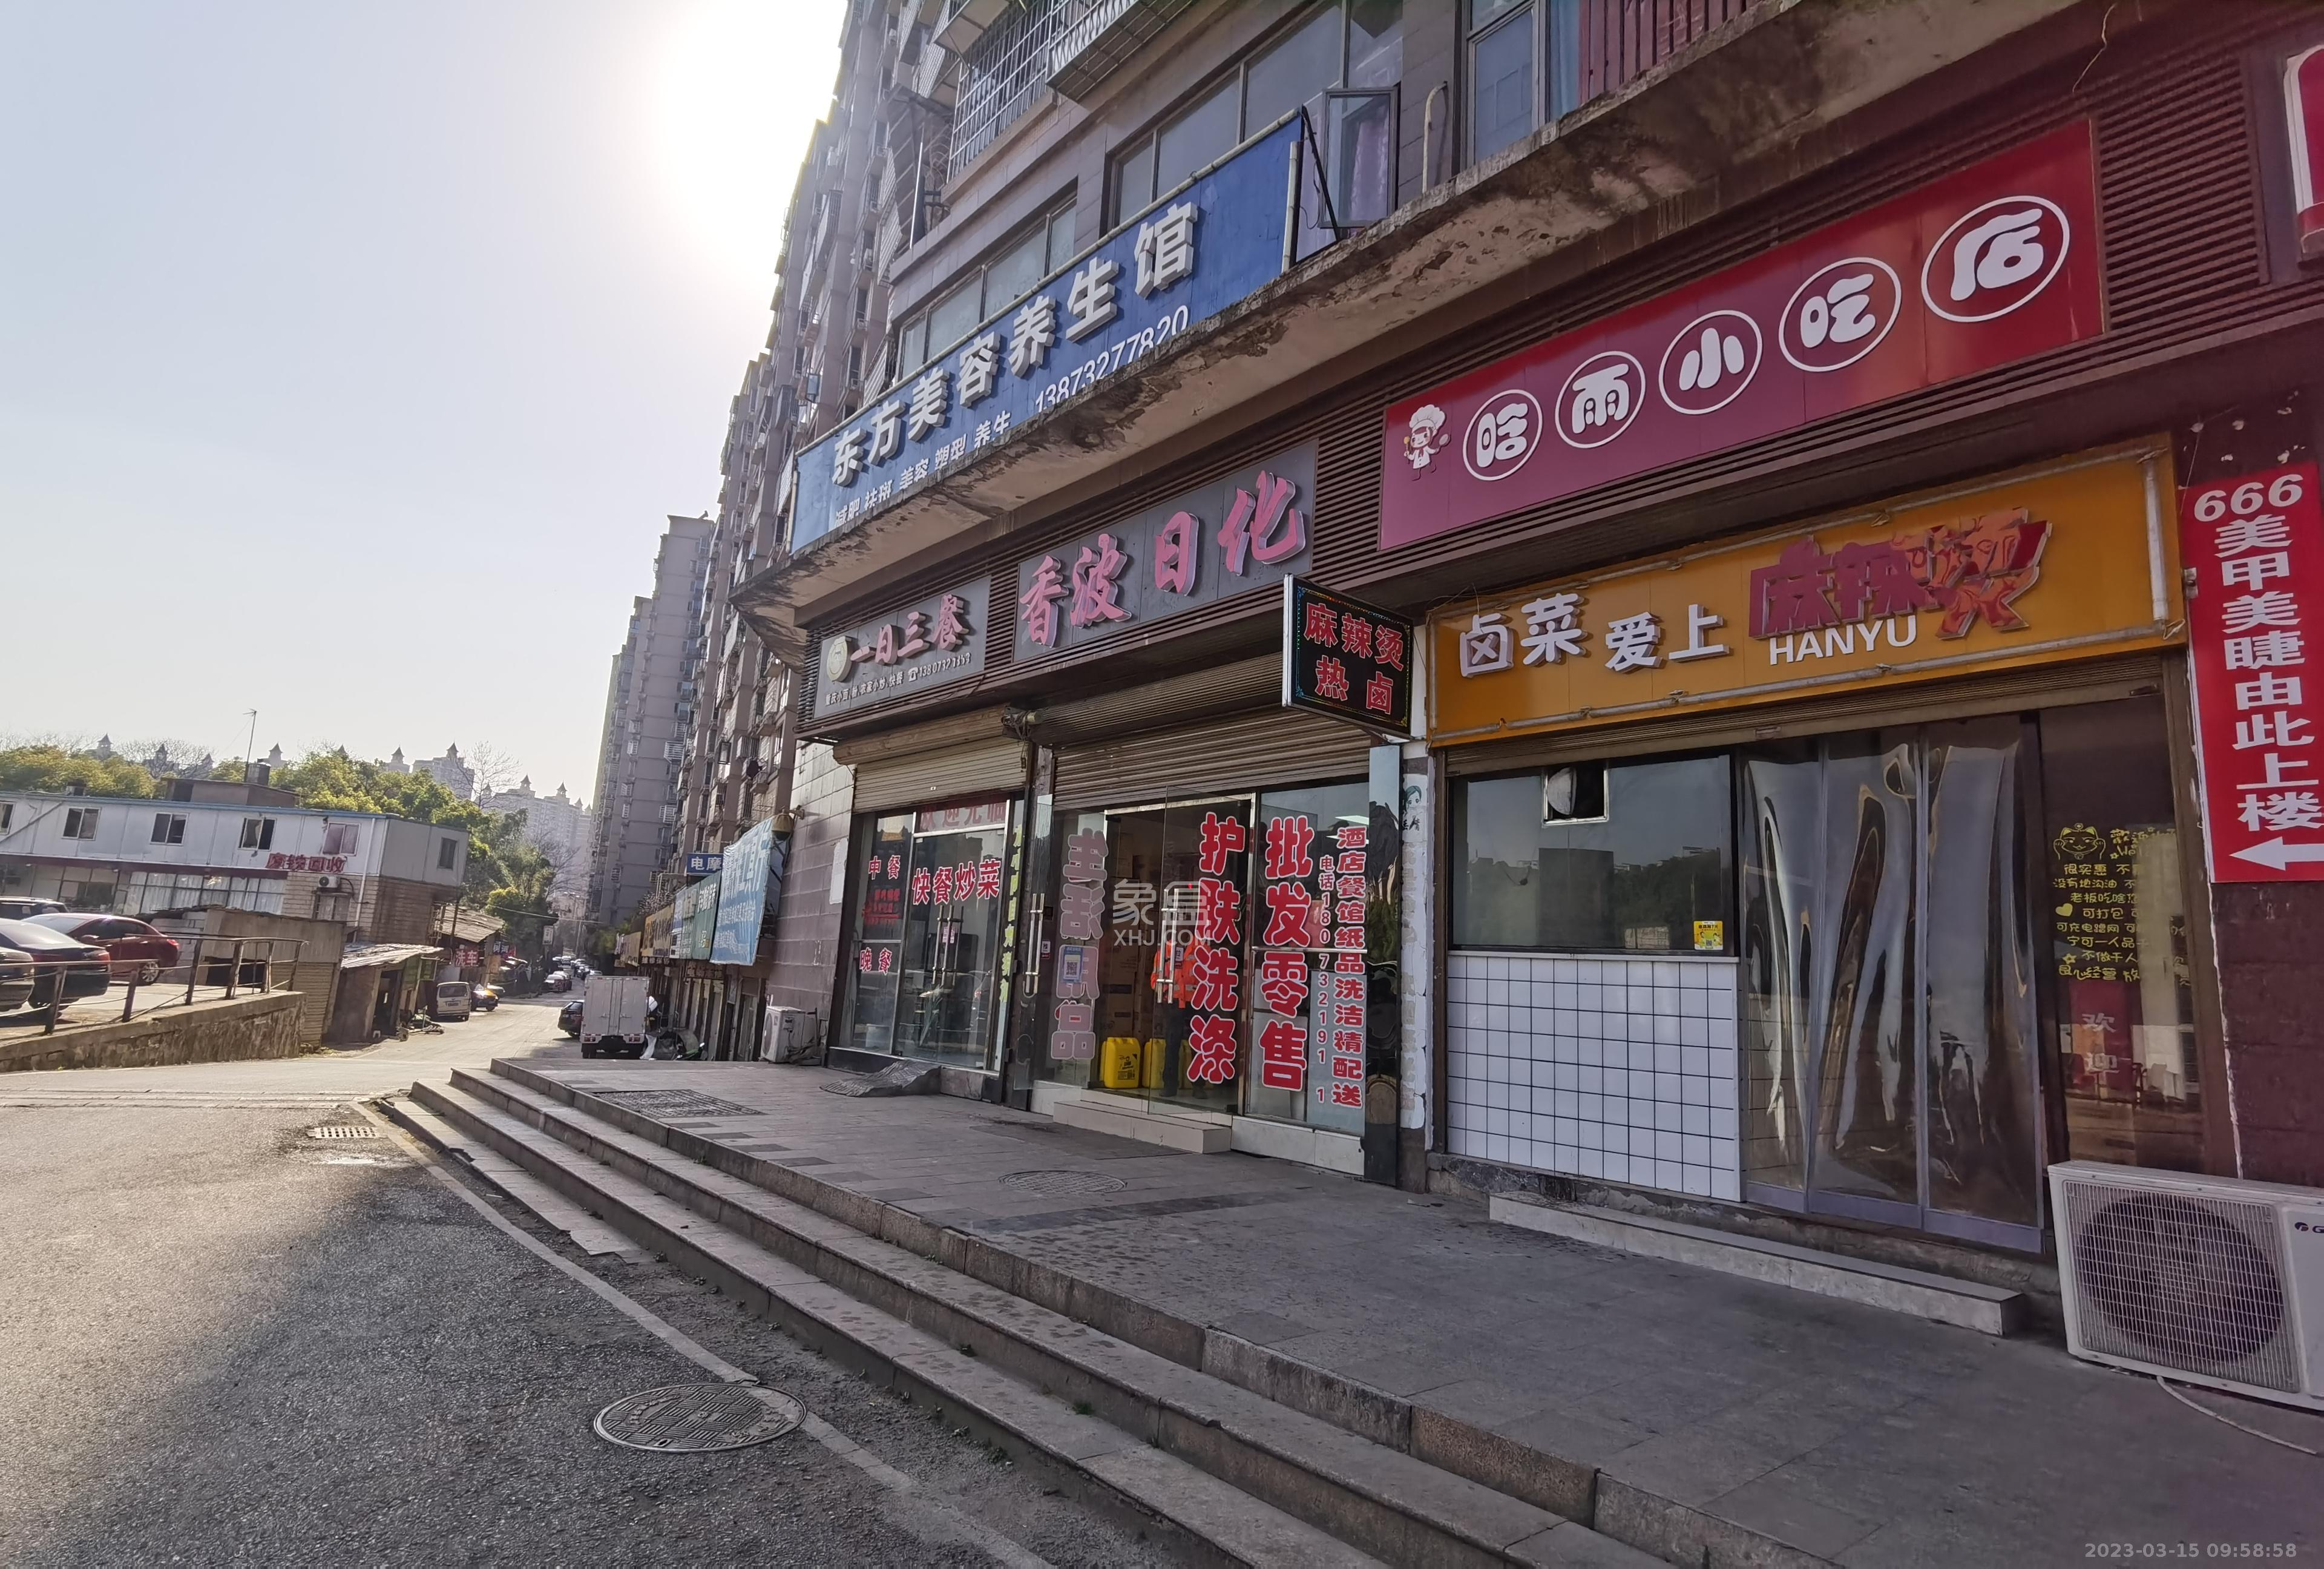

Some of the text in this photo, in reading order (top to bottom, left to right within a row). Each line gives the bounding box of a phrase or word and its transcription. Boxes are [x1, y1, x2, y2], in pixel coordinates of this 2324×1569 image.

[832, 202, 1198, 487] 东方美容养生馆
[1035, 304, 1189, 413] 13873277820
[833, 496, 861, 528] 减肥
[899, 457, 930, 490] 美容
[934, 433, 967, 471] 塑型
[2194, 474, 2304, 522] 666
[1019, 469, 1306, 648] 香波日化
[850, 593, 968, 666] 一日三餐
[1304, 602, 1404, 671] 麻辣烫
[1770, 615, 1917, 666] HANYU
[1315, 655, 1393, 715] 热卤
[2214, 514, 2324, 831] 美甲美睫由此上楼
[691, 857, 723, 870] 电摩
[868, 854, 901, 880] 中餐
[911, 858, 1002, 906] 快餐炒菜
[2052, 878, 2117, 889] 没有地沟油
[2056, 923, 2119, 933] 可充电蹭网
[2083, 908, 2124, 919] 可打包
[456, 950, 479, 967] 洗车
[859, 946, 893, 976] 晚餐
[1186, 811, 1246, 1085] 护肤洗涤
[1258, 815, 1315, 1091] 批发零售
[1331, 825, 1368, 1109] 酒店餐馆纸品洗洁精配送
[2059, 965, 2117, 981] 良心经营
